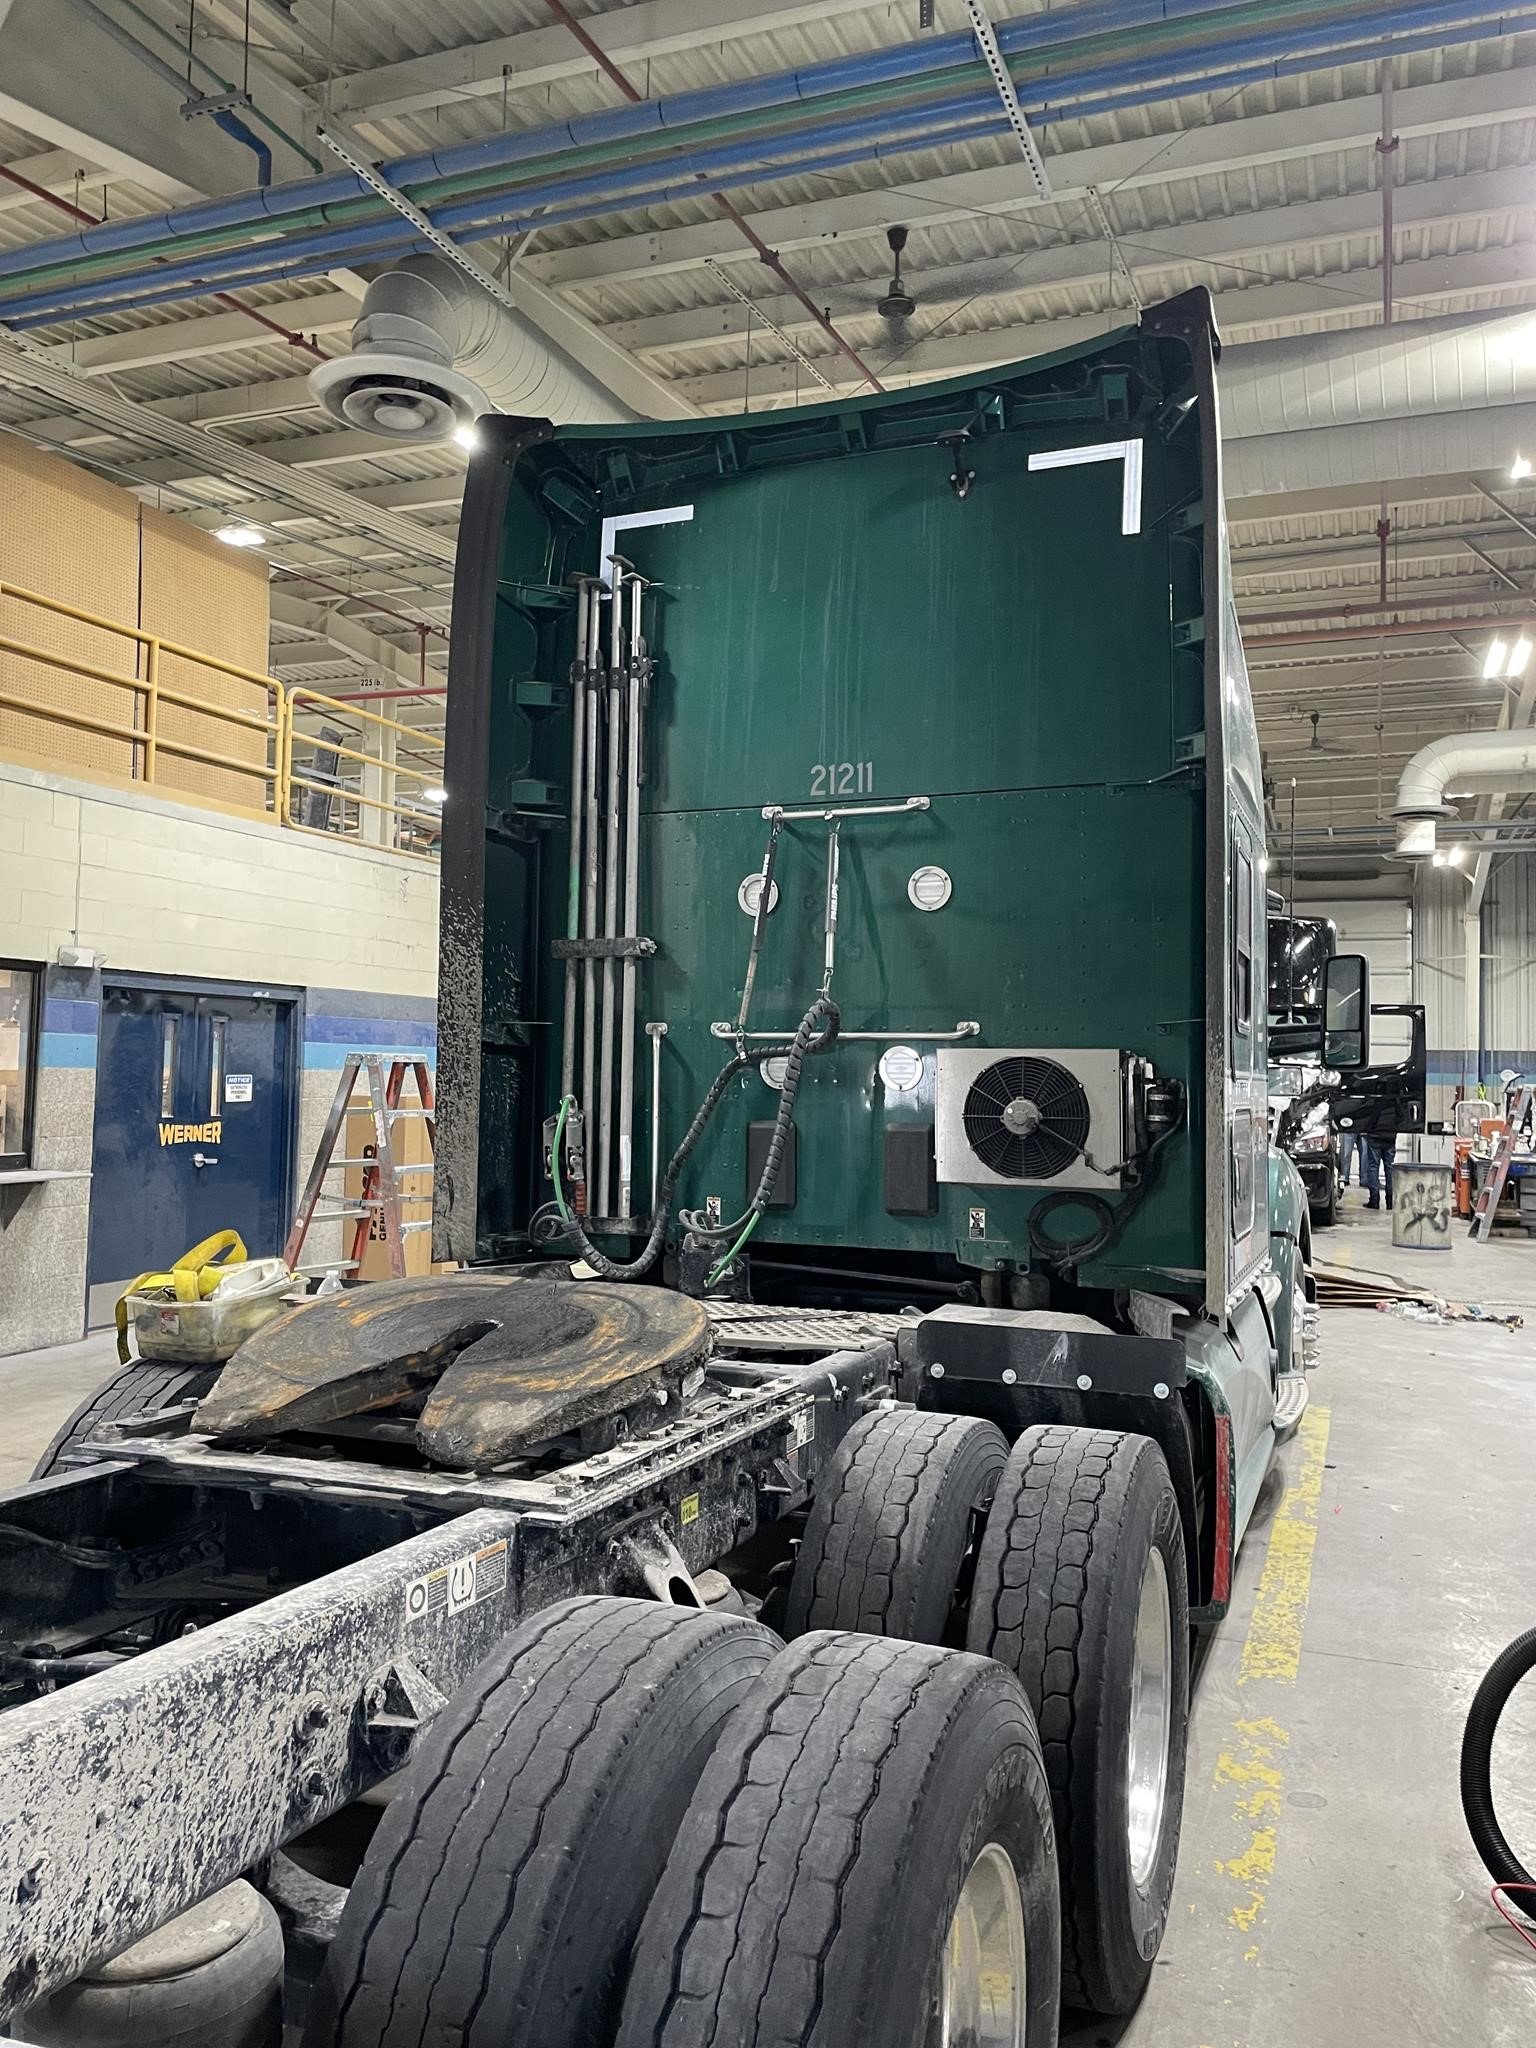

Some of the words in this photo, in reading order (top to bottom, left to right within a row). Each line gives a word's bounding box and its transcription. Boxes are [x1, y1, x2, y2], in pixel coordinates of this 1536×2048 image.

[360, 679, 373, 687] 225
[810, 761, 873, 796] 21211
[159, 1121, 222, 1147] WERNER
